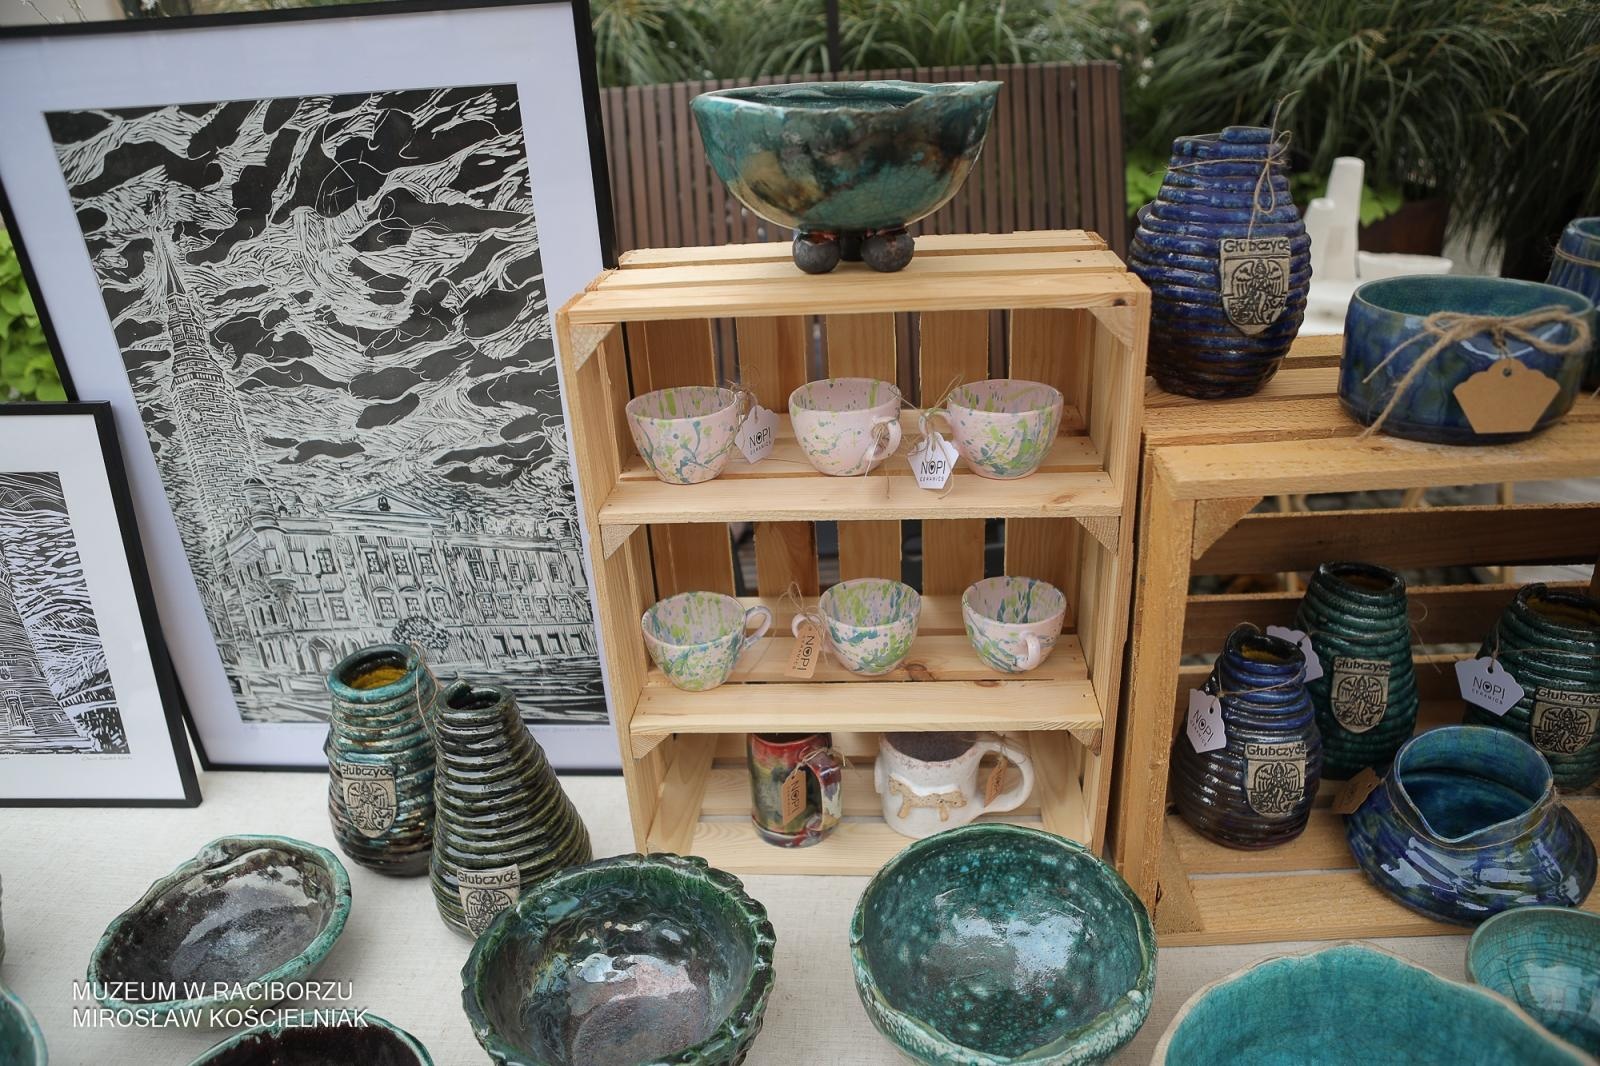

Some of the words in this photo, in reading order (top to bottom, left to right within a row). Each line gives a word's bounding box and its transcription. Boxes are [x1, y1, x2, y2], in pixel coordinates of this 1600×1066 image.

[749, 426, 771, 449] NOPI
[920, 460, 946, 475] NOPI
[797, 635, 815, 671] NOPI
[1472, 675, 1505, 700] NOPI
[1192, 709, 1214, 743] NOPI
